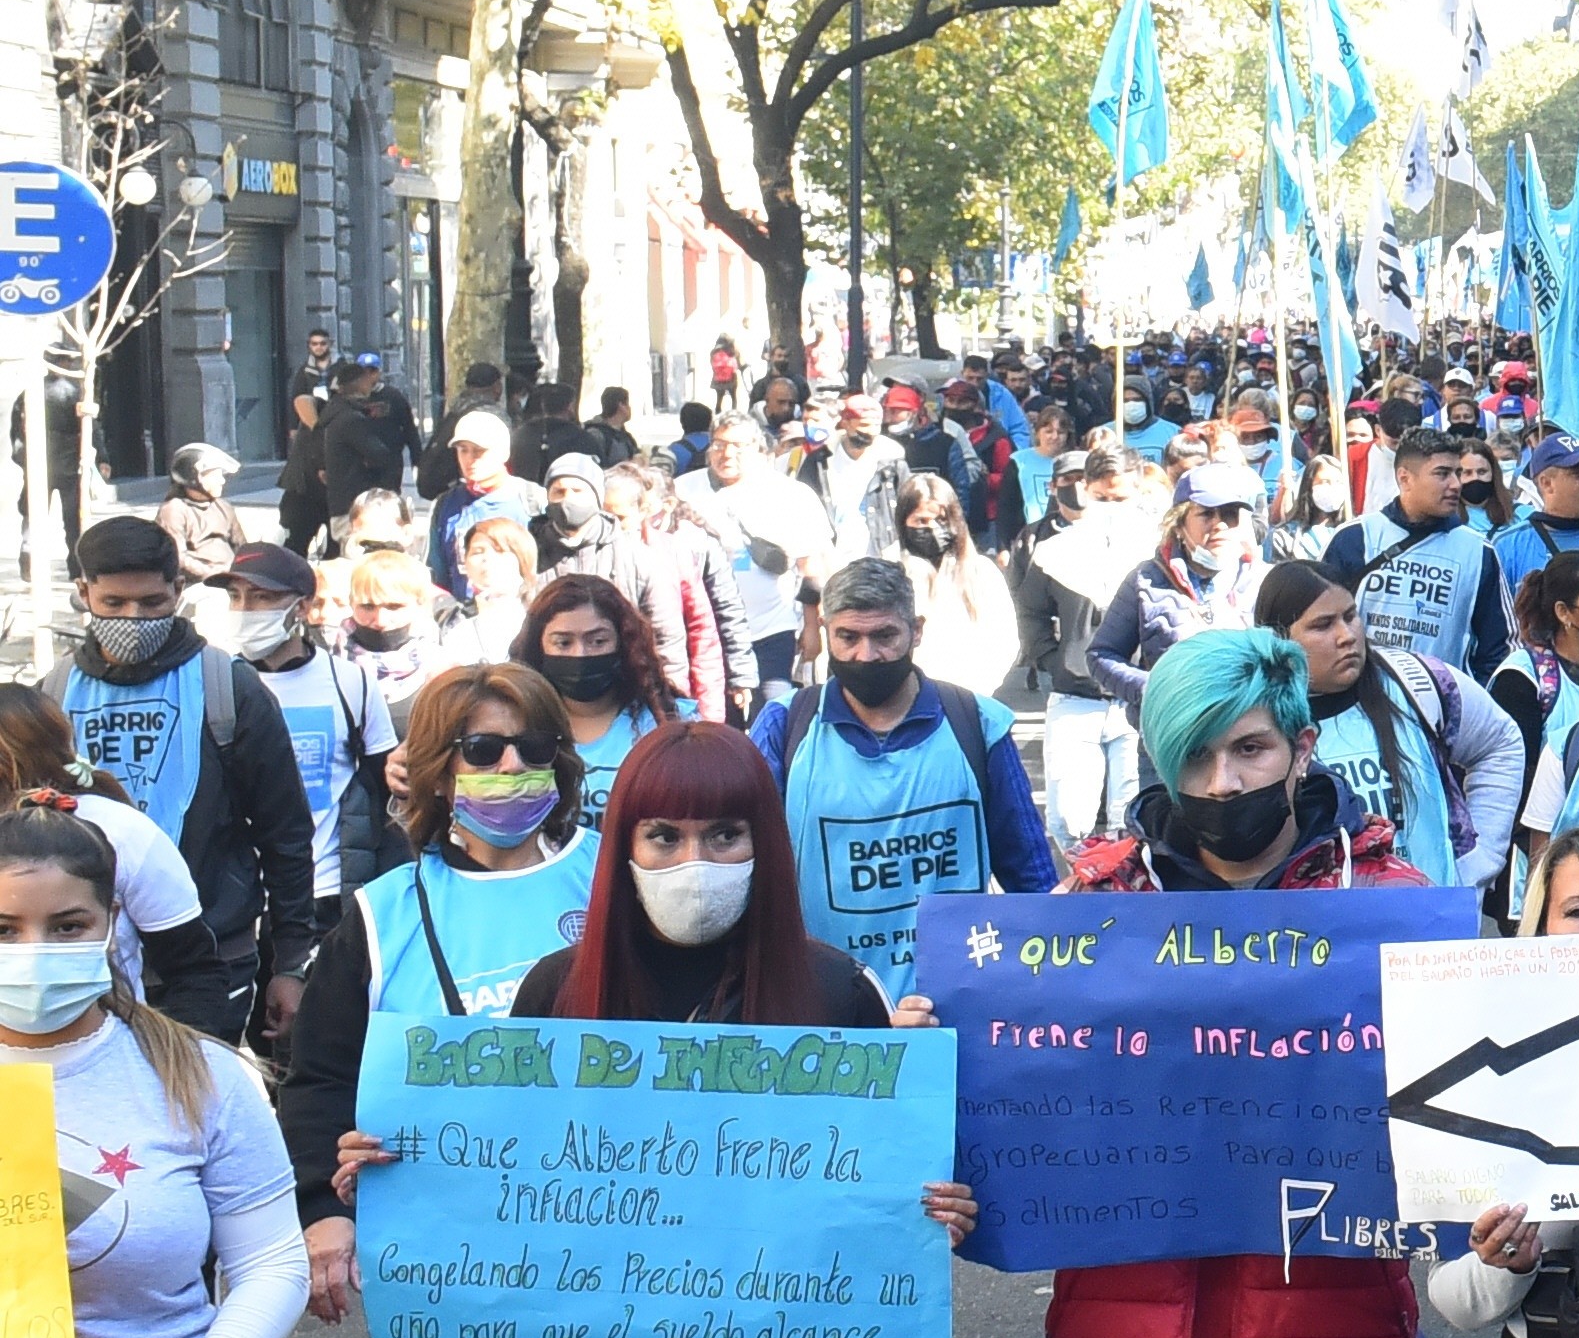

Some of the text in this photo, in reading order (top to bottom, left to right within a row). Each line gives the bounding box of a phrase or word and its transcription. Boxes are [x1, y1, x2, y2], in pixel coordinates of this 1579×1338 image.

[241, 157, 299, 196] AEROBOX
[1364, 572, 1453, 607] DE PIE
[848, 826, 958, 863] BARRIOS
[850, 848, 961, 893] DE PIE
[847, 932, 888, 951] LOS
[889, 950, 915, 967] LA
[1528, 961, 1549, 976] UN
[540, 1118, 862, 1183] Alberto la
[1319, 1211, 1438, 1253] LIBRES
[378, 1241, 919, 1307] Congelando los Precios durante un
